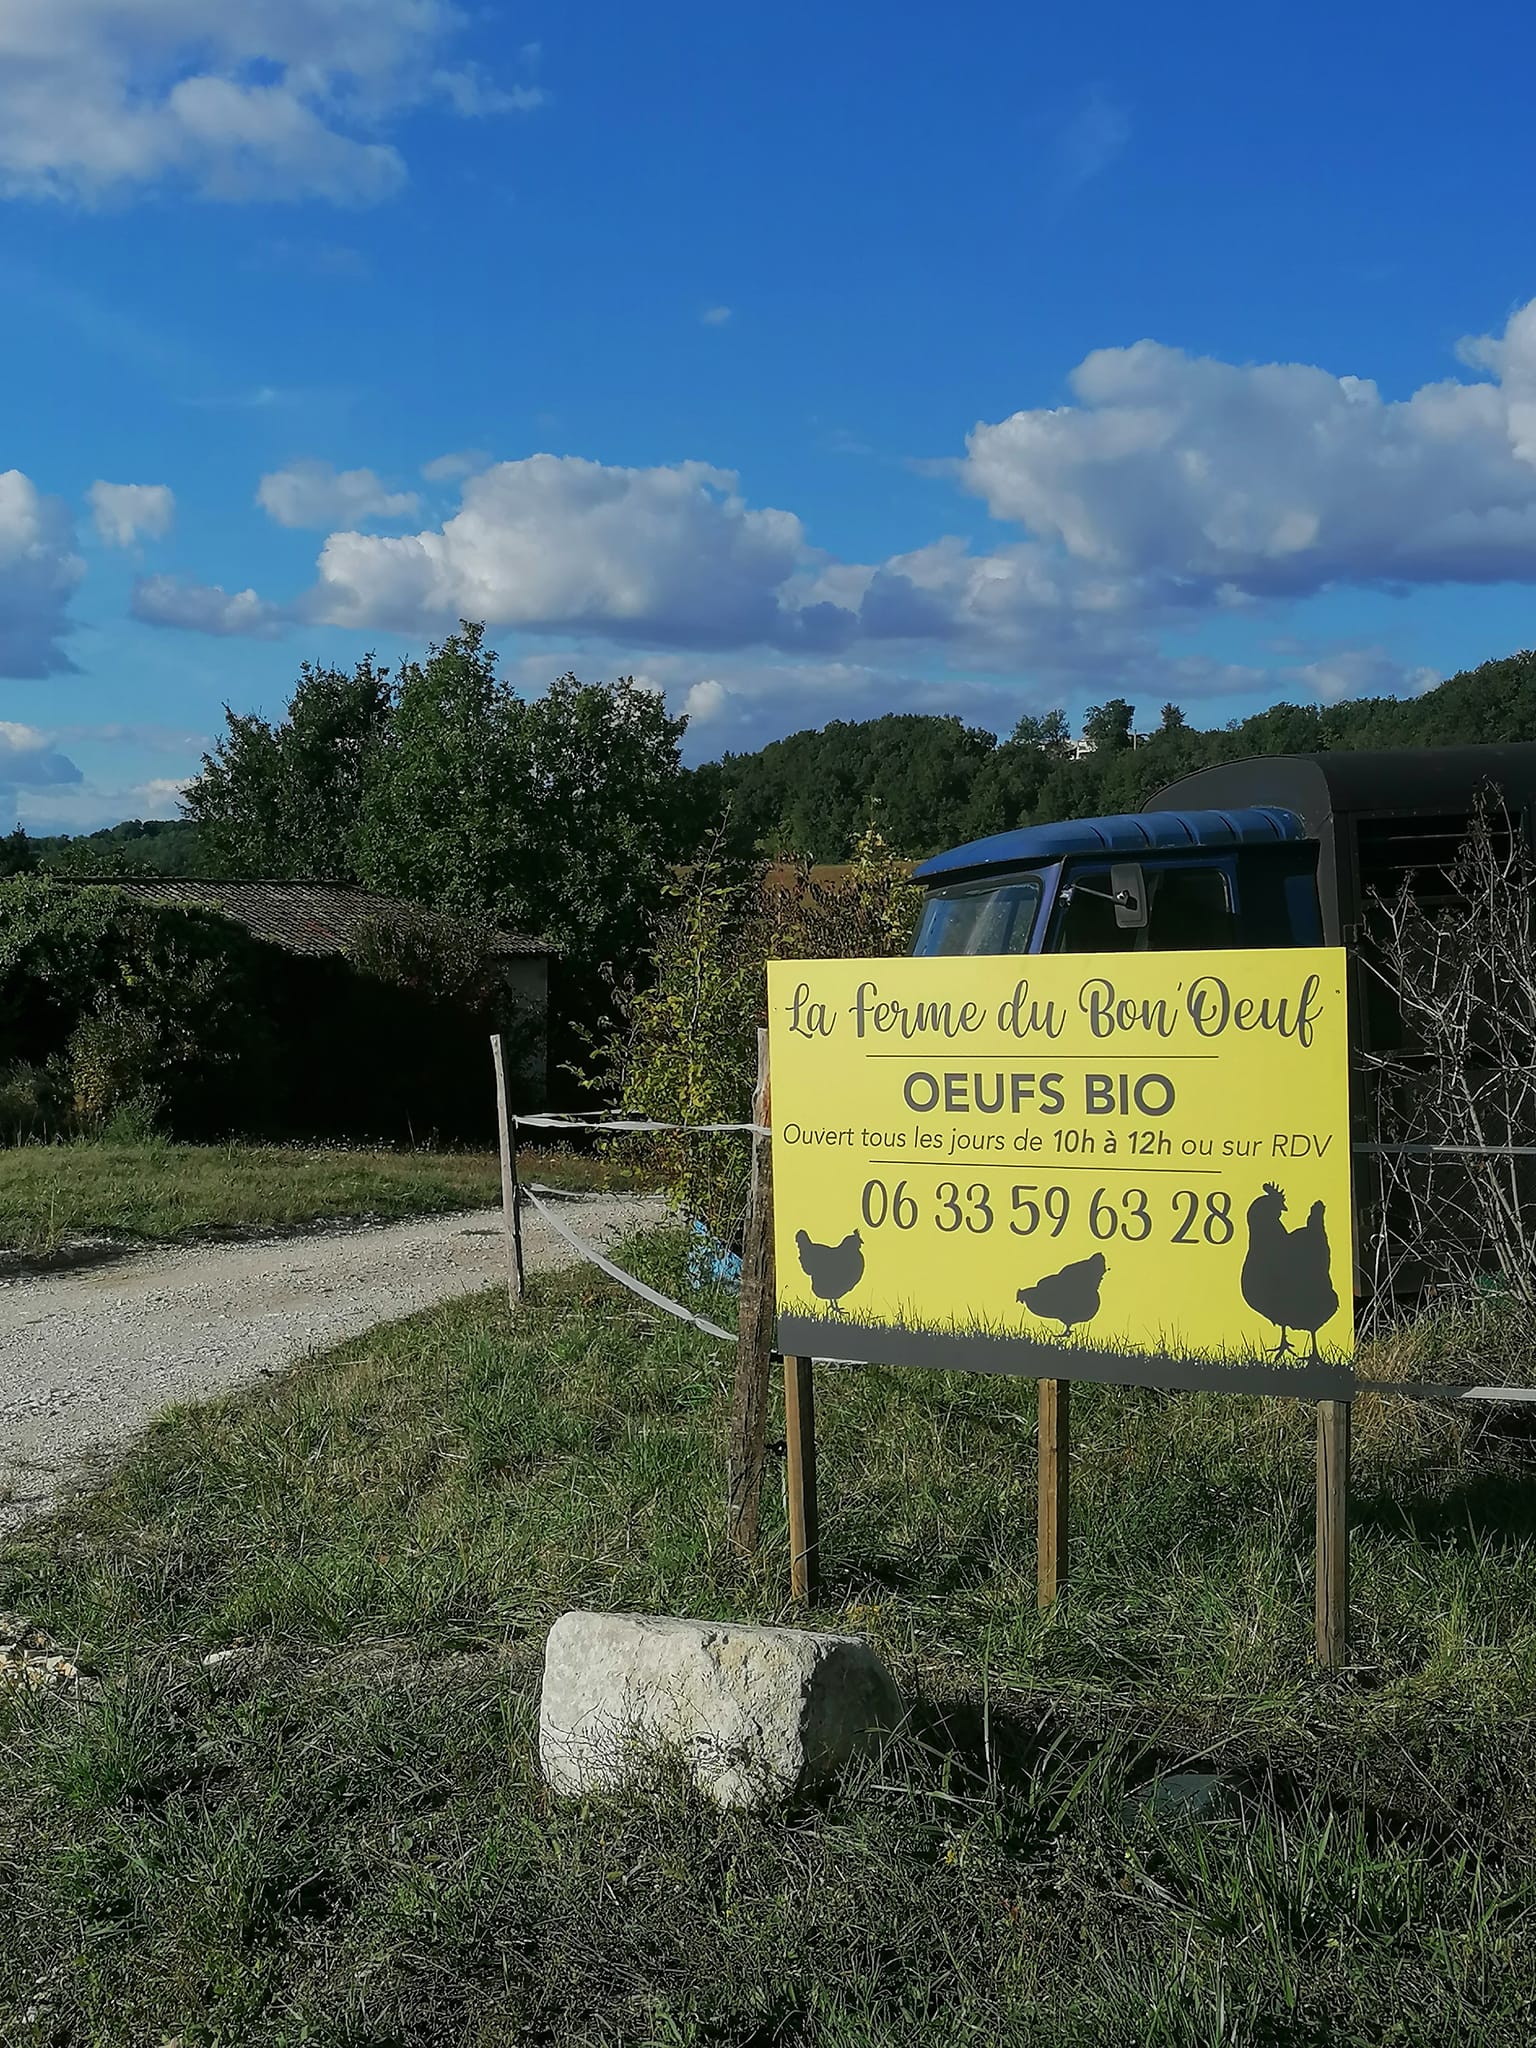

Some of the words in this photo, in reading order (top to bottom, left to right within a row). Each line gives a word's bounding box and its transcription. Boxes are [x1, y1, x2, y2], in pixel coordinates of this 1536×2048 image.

[784, 982, 838, 1039] La
[997, 979, 1067, 1039] du
[903, 1071, 1065, 1115] OEUFS
[1085, 1073, 1176, 1117] BIO
[783, 1123, 855, 1146] Ouvert
[860, 1128, 906, 1148] tous
[914, 1125, 943, 1149] les
[947, 1127, 1005, 1156] jours
[1013, 1127, 1043, 1152] de
[1053, 1128, 1095, 1154] 10h
[1103, 1129, 1117, 1154] à
[1127, 1129, 1172, 1155] 12h
[1181, 1139, 1213, 1156] ou
[1221, 1140, 1263, 1157] sur
[1271, 1134, 1333, 1158] RDV
[861, 1179, 918, 1230] 06
[934, 1181, 994, 1234] 33
[1009, 1184, 1070, 1238] 59
[1089, 1187, 1153, 1242] 63
[1170, 1190, 1235, 1245] 28
